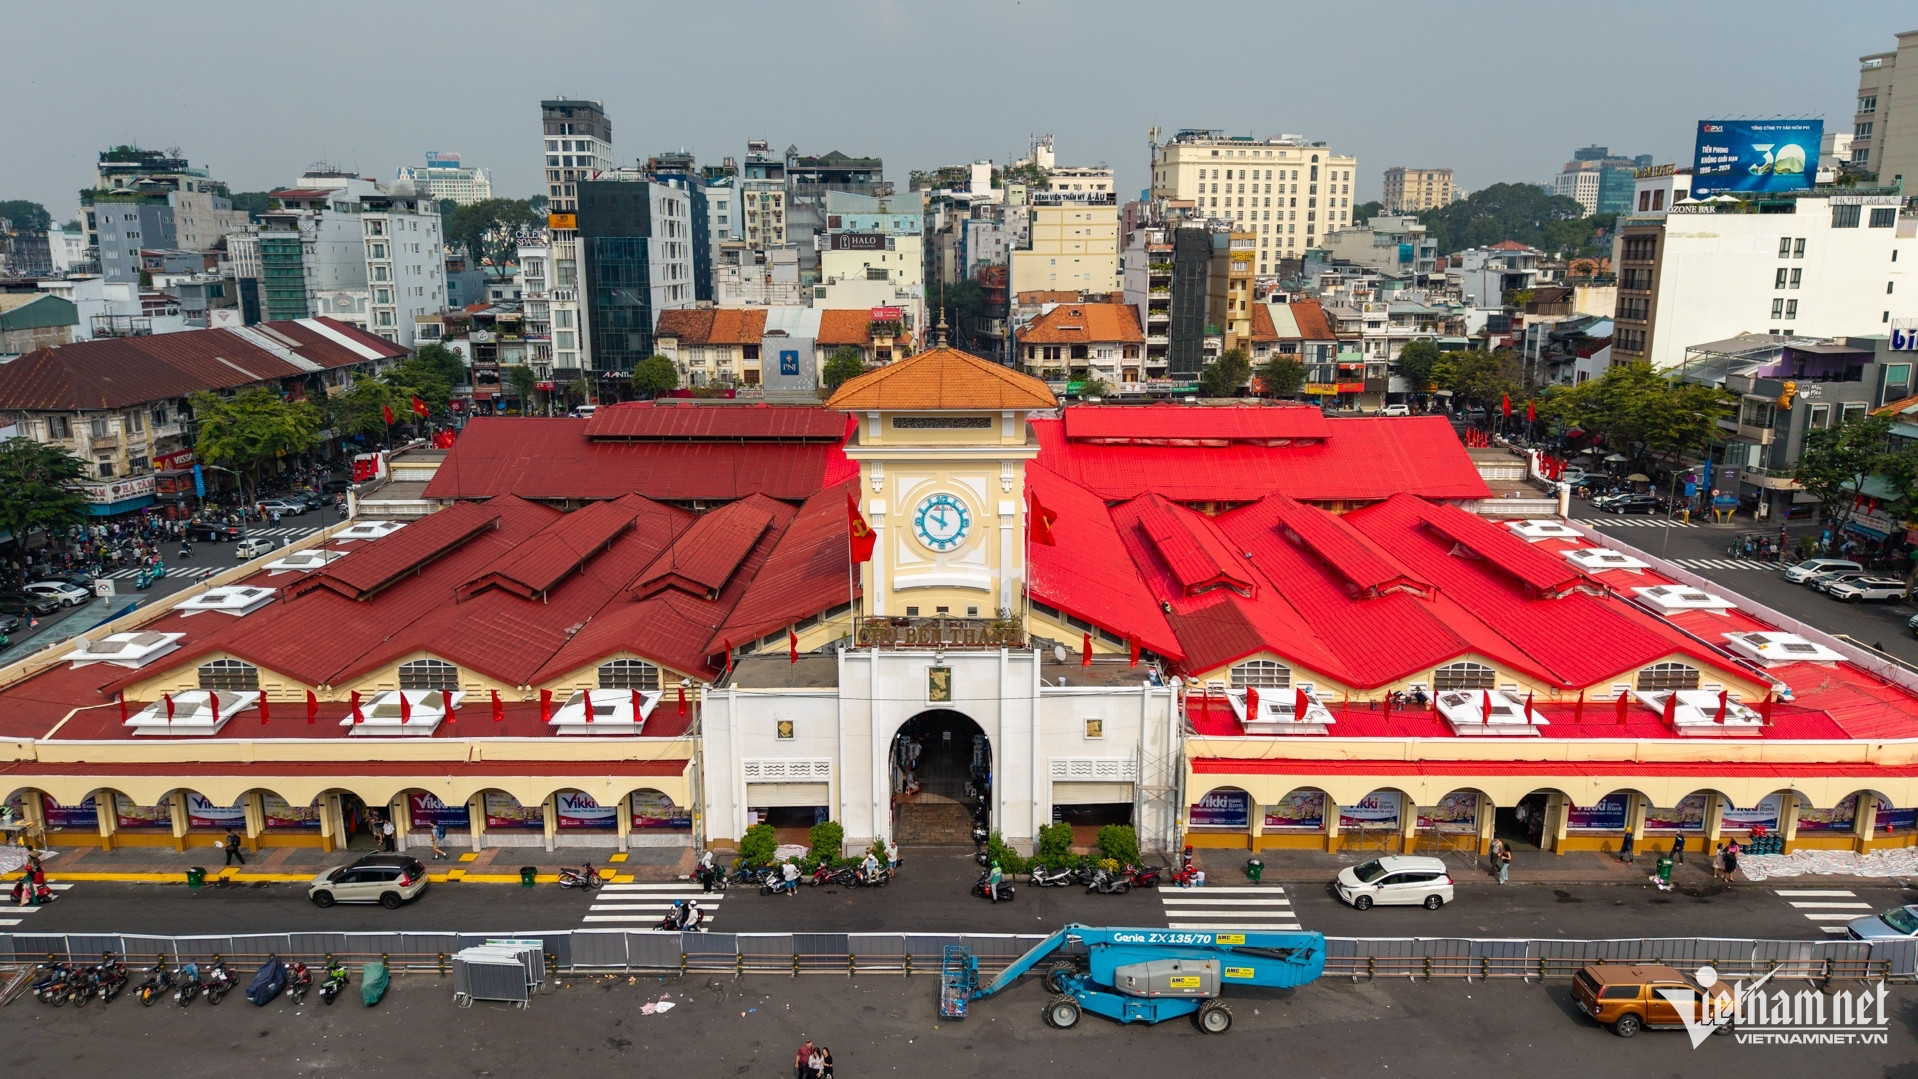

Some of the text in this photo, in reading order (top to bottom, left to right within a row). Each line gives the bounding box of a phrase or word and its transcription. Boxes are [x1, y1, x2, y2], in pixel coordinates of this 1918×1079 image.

[1666, 205, 1716, 213] OZONE BAR
[516, 239, 533, 248] SPA
[852, 236, 876, 244] HALO
[1893, 330, 1918, 350] bi
[783, 363, 797, 372] PNJ
[121, 479, 154, 494] HÀ TÂM
[562, 792, 595, 809] Vikki
[1113, 932, 1145, 943] Genie
